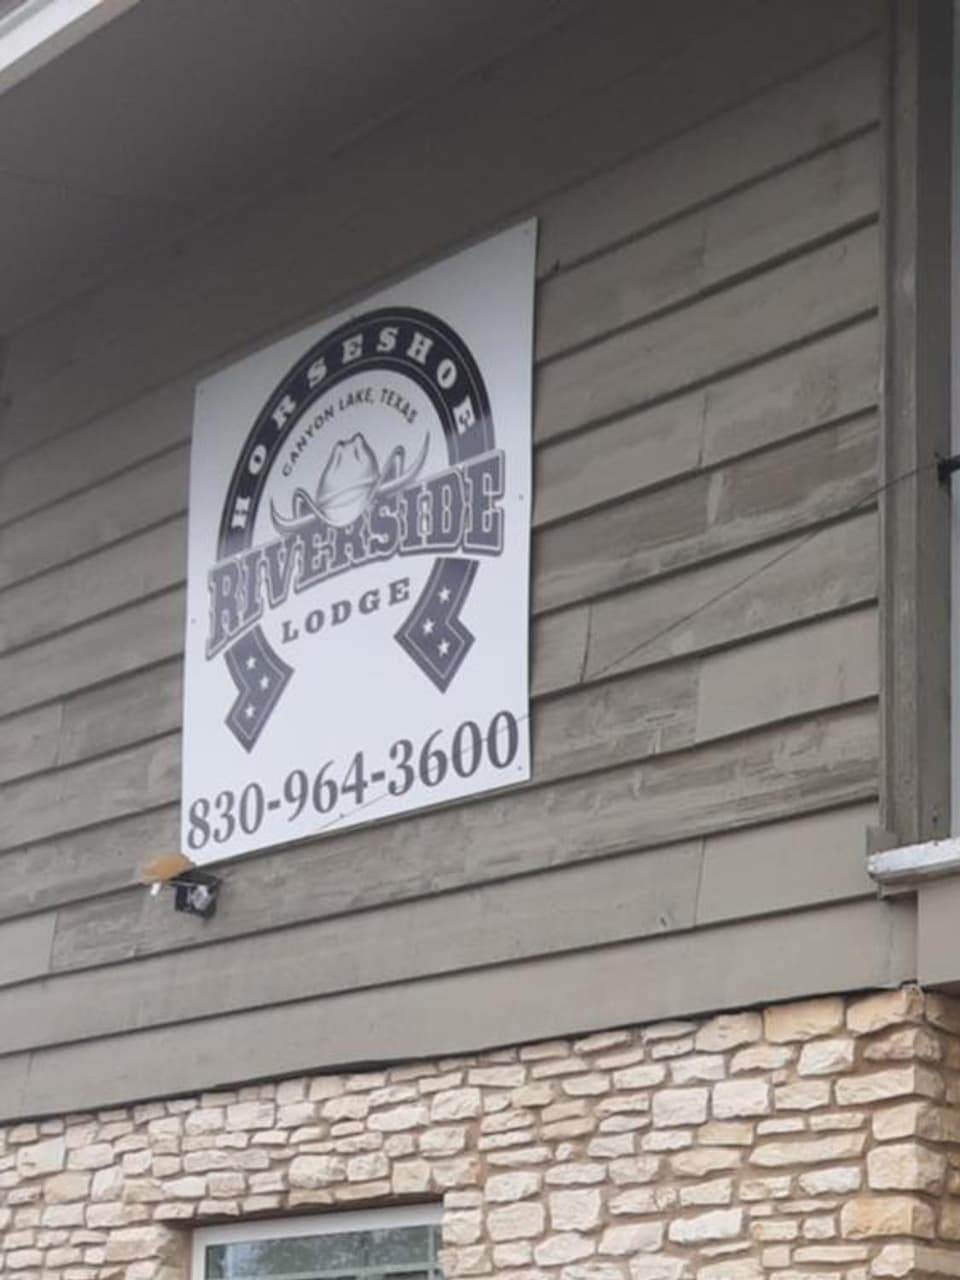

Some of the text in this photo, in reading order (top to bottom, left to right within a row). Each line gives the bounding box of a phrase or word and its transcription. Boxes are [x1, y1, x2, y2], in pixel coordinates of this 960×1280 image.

[230, 326, 475, 529] HORSESHOE
[281, 404, 335, 477] CANYON
[380, 388, 419, 425] TEXAS
[205, 449, 506, 662] RIVERSIDE
[280, 577, 412, 645] LODGE
[186, 709, 520, 851] 830-964-3600
